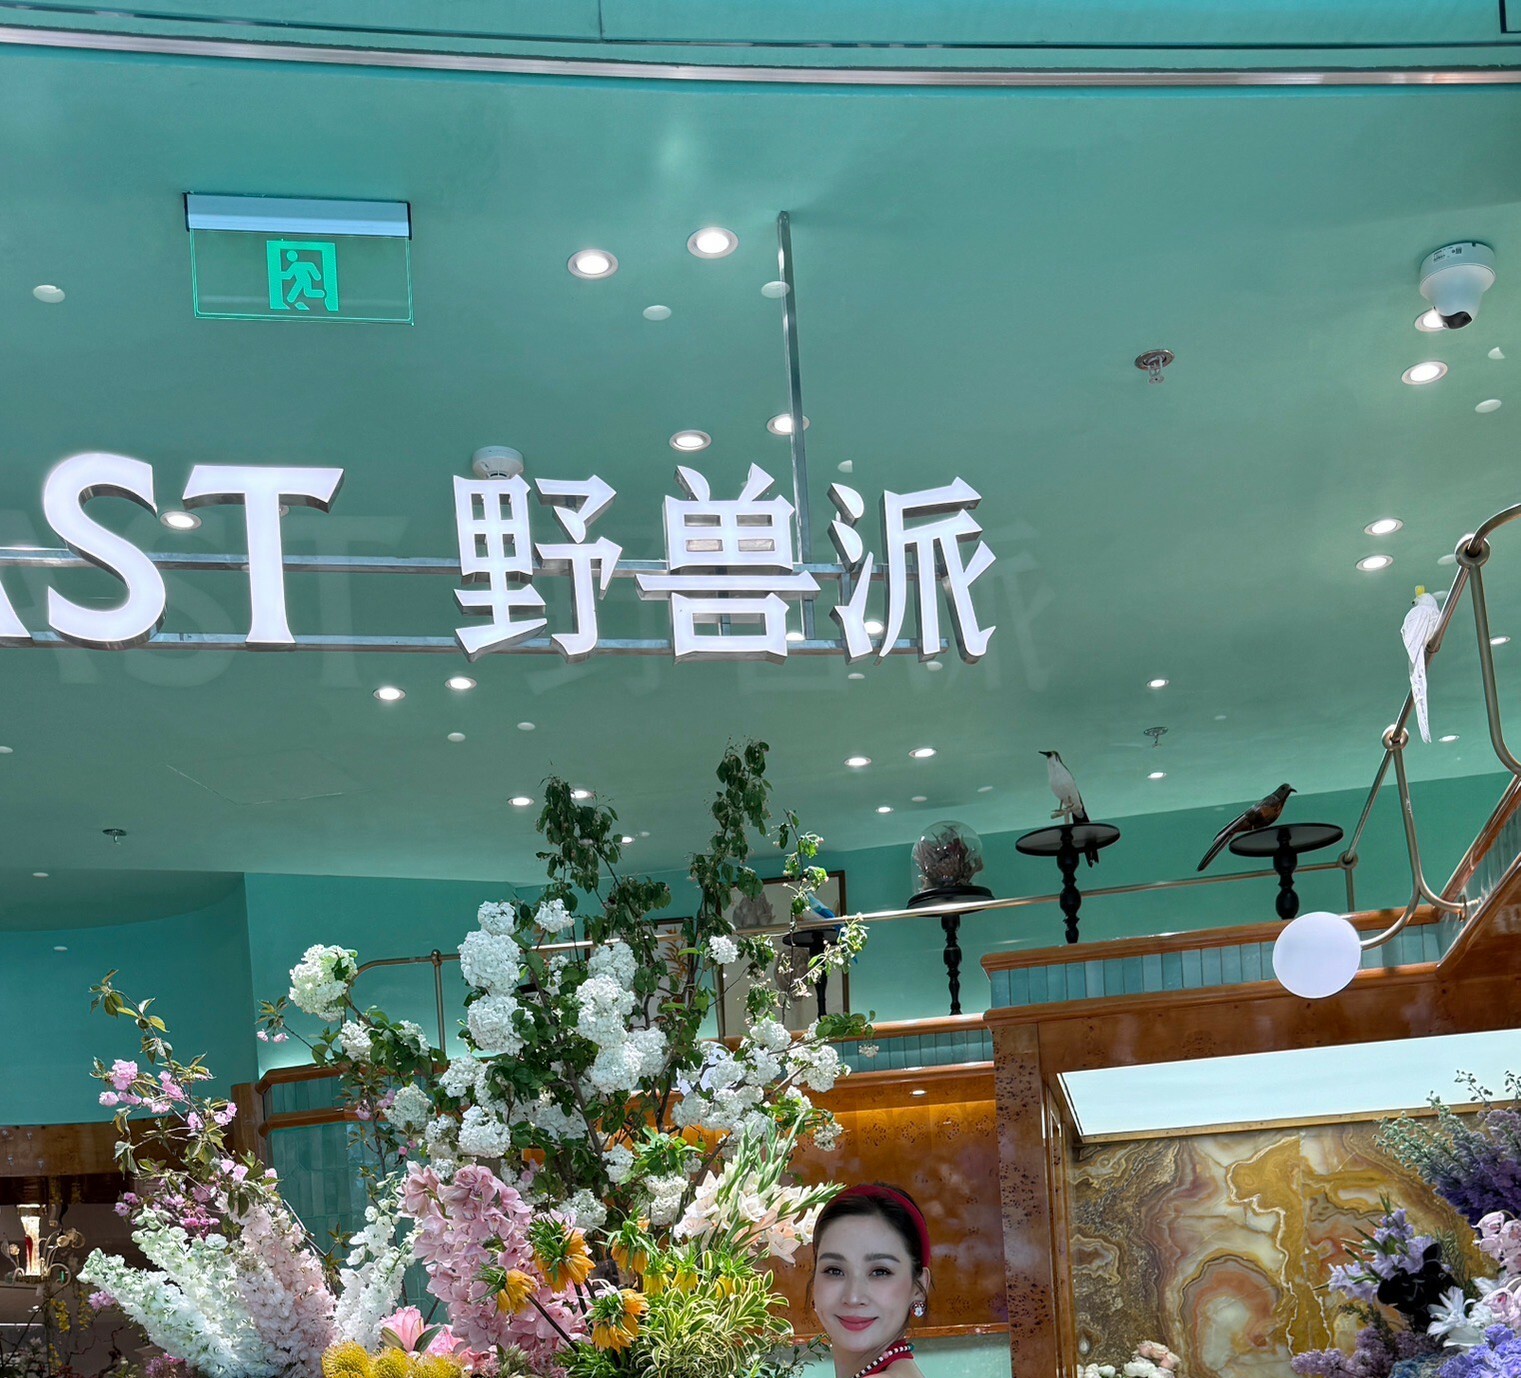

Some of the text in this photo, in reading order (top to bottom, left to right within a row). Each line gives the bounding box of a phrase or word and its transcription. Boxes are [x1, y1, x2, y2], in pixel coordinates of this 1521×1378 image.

[0, 452, 345, 648] ST
[453, 462, 997, 664] 野兽派
